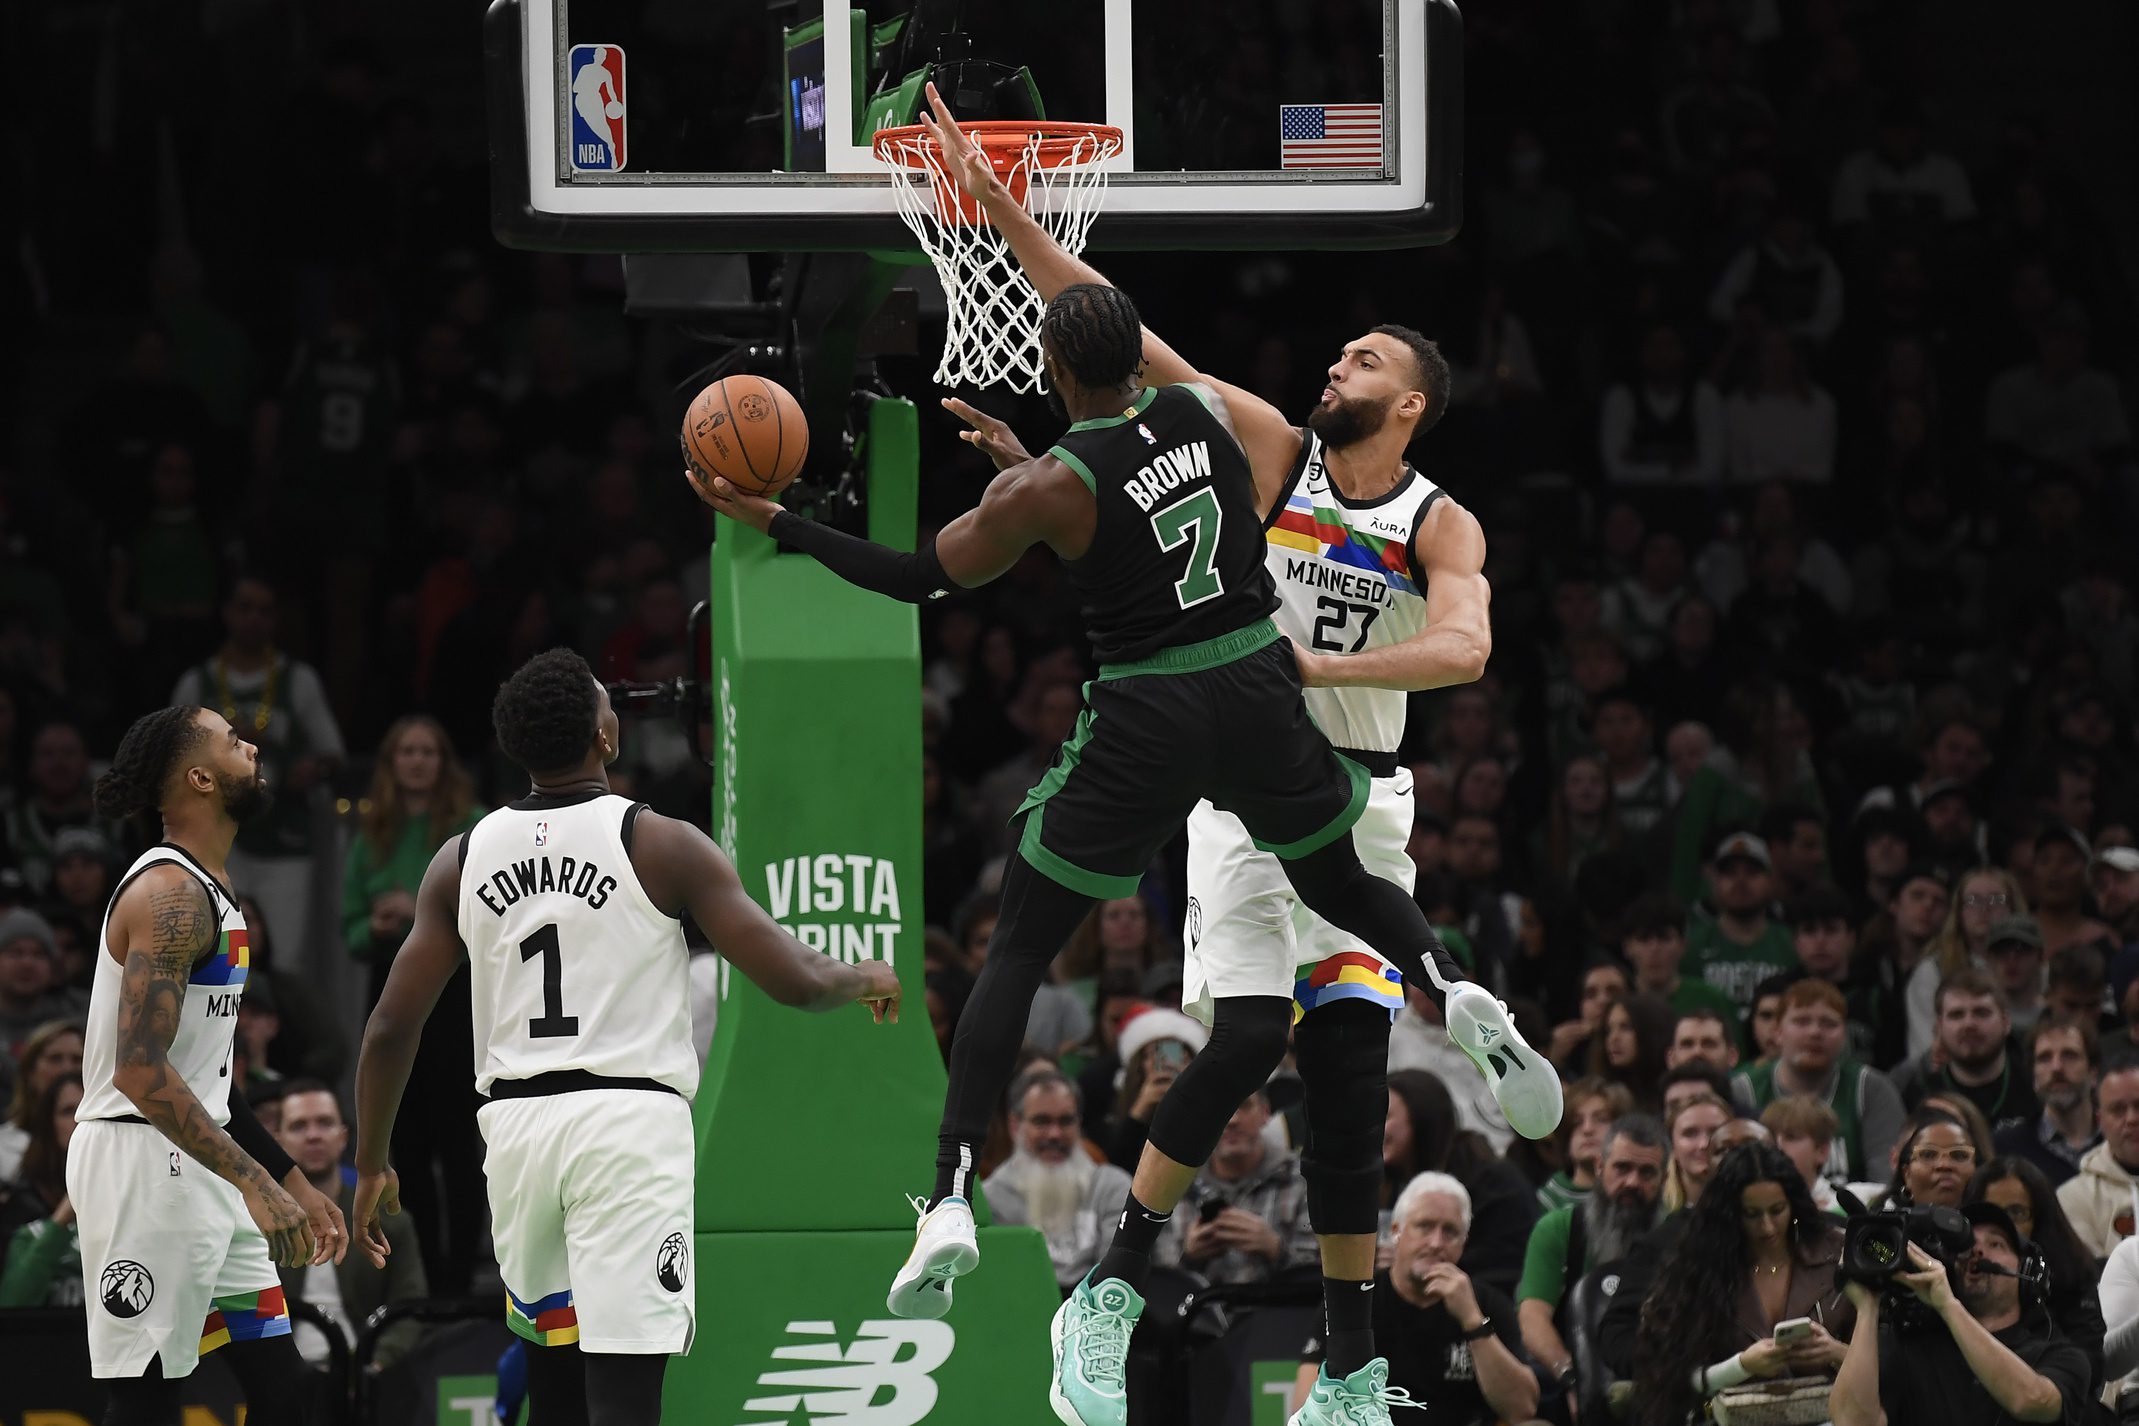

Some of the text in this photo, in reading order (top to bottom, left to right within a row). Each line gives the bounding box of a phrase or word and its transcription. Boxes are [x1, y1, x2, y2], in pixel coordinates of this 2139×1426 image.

[578, 144, 606, 164] NBA
[1123, 440, 1212, 513] BROWN
[1150, 485, 1225, 610] 7
[1286, 557, 1395, 611] MINNESO
[1312, 595, 1380, 653] 27
[476, 856, 618, 918] EDWARDS
[765, 853, 902, 921] VISTA
[778, 923, 902, 968] RINT
[206, 993, 243, 1018] MIN
[519, 923, 579, 1039] 1
